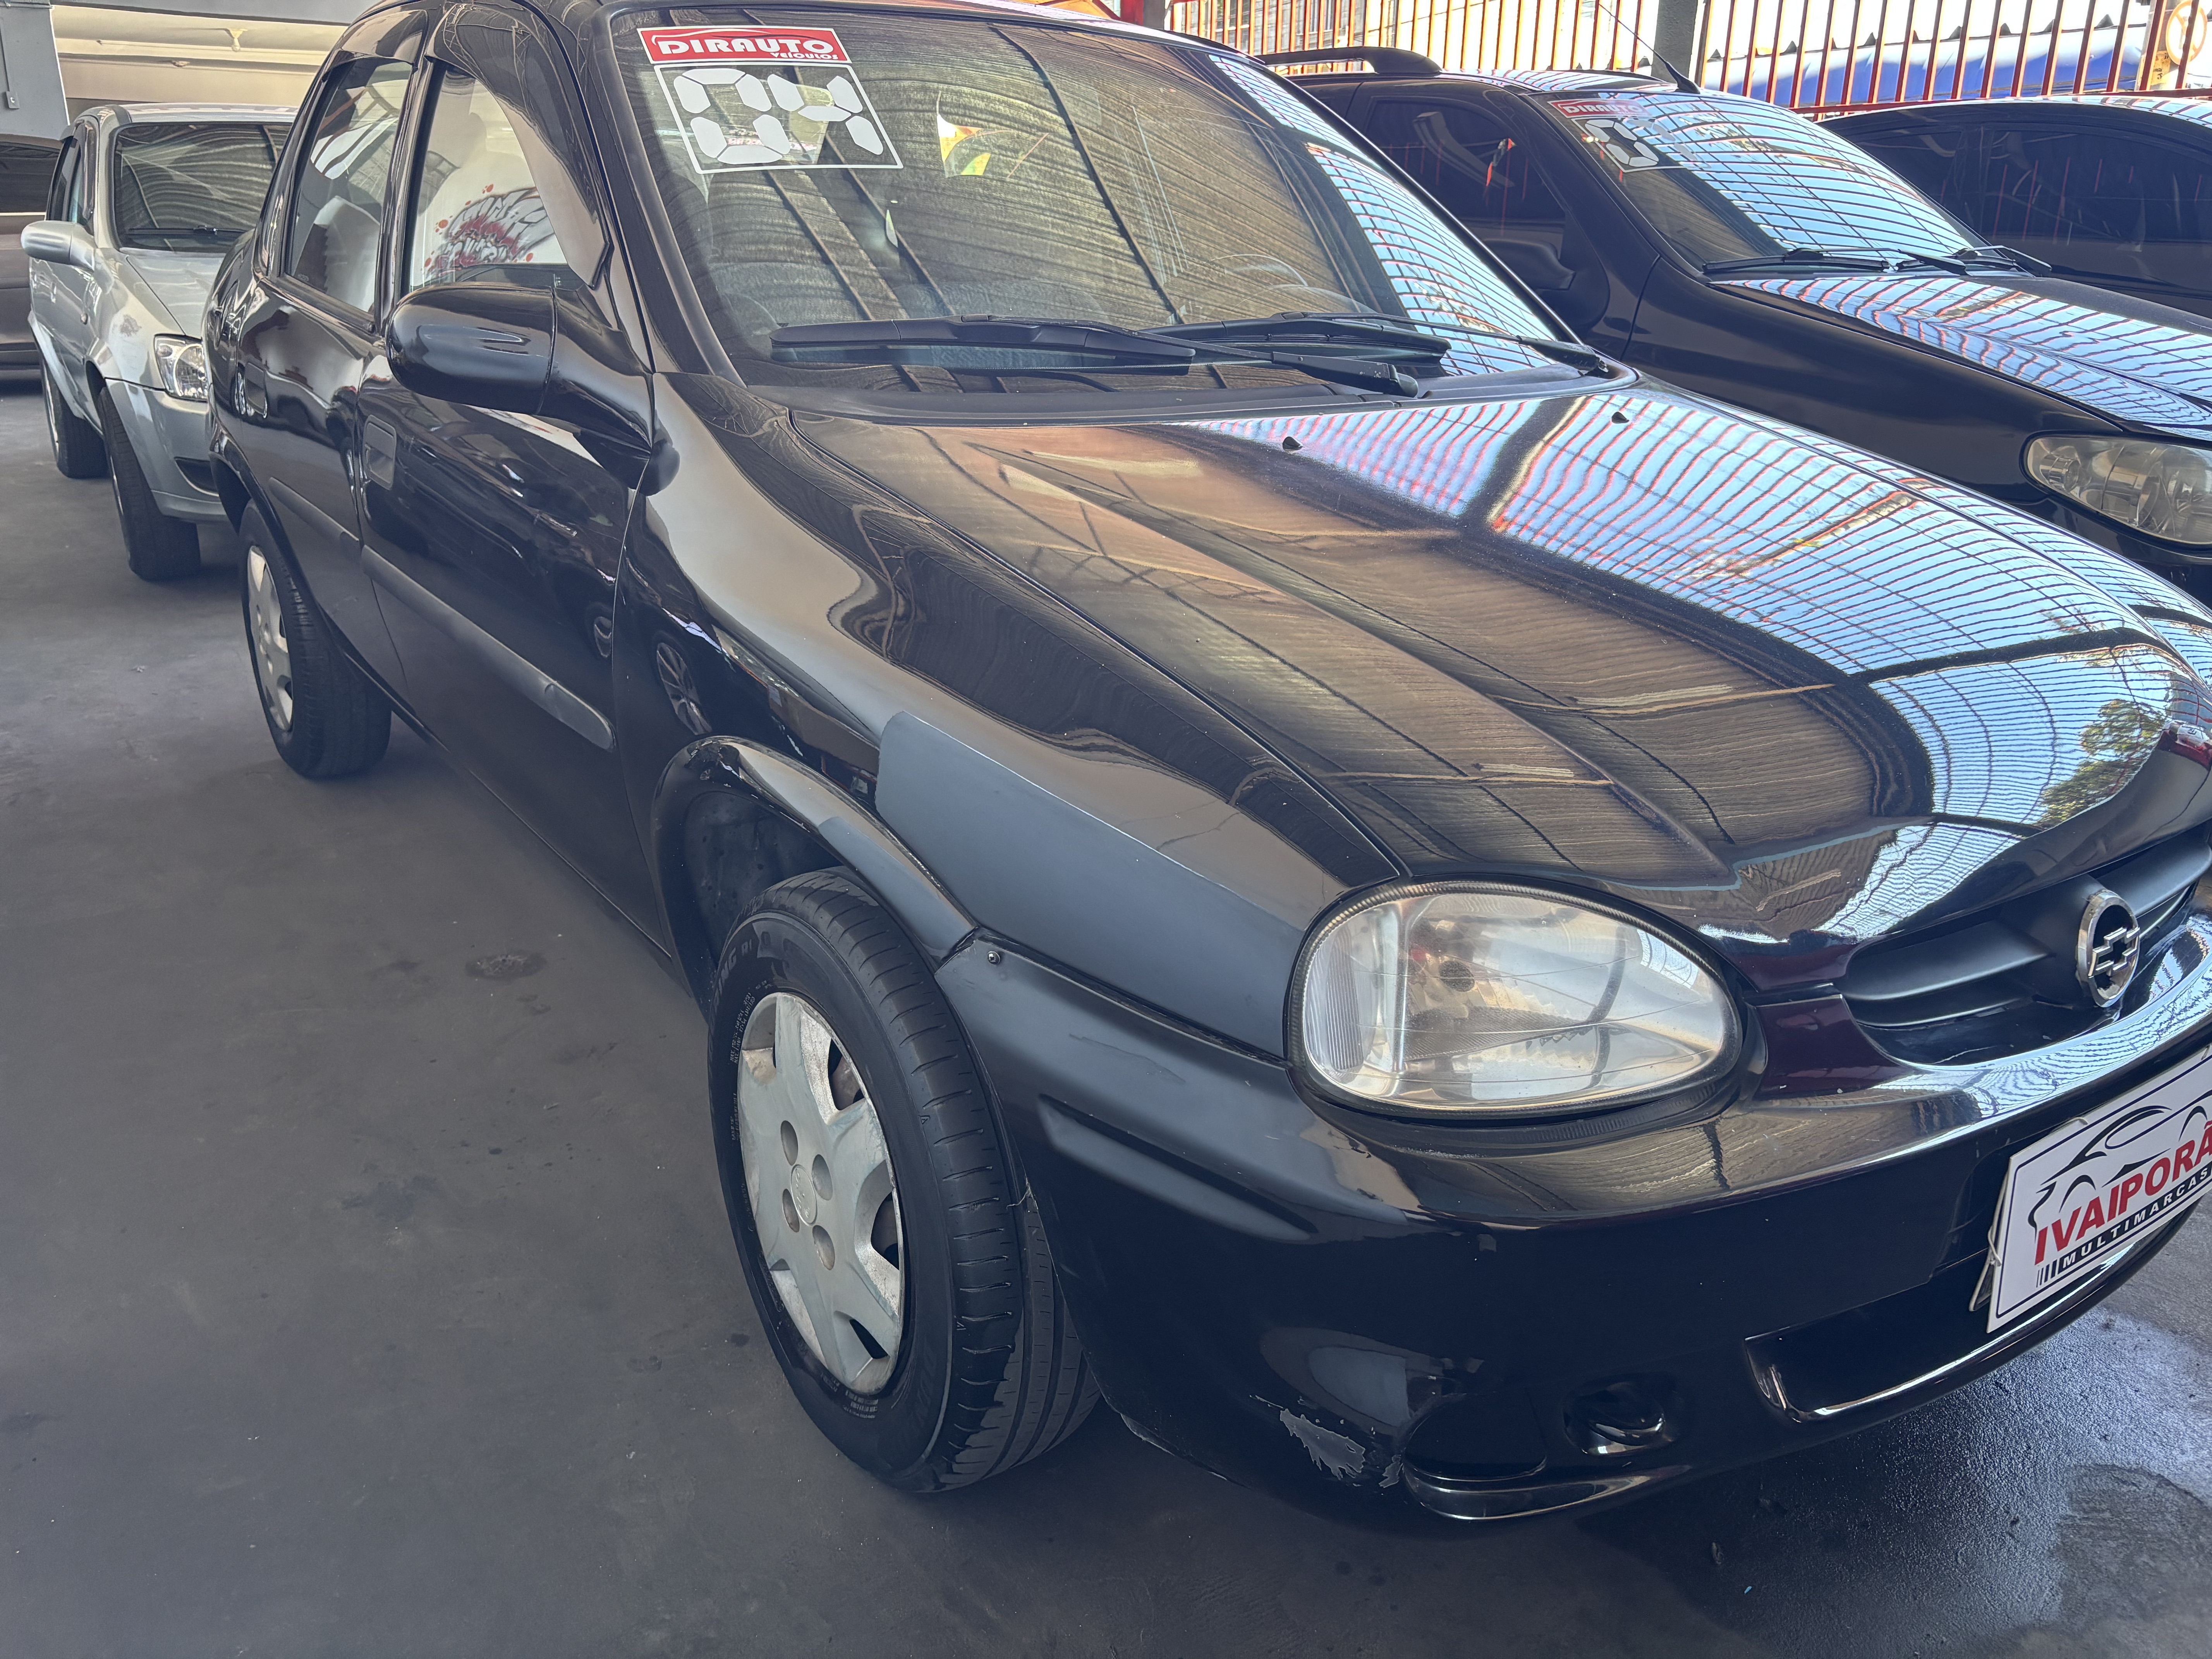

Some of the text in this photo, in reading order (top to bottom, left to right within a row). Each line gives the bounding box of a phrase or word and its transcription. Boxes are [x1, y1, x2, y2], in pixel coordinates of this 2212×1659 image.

[658, 38, 834, 55] DIRAUTO
[1563, 105, 1643, 113] DIRAUTO
[2062, 1167, 2208, 1270] MULTIMARCAS
